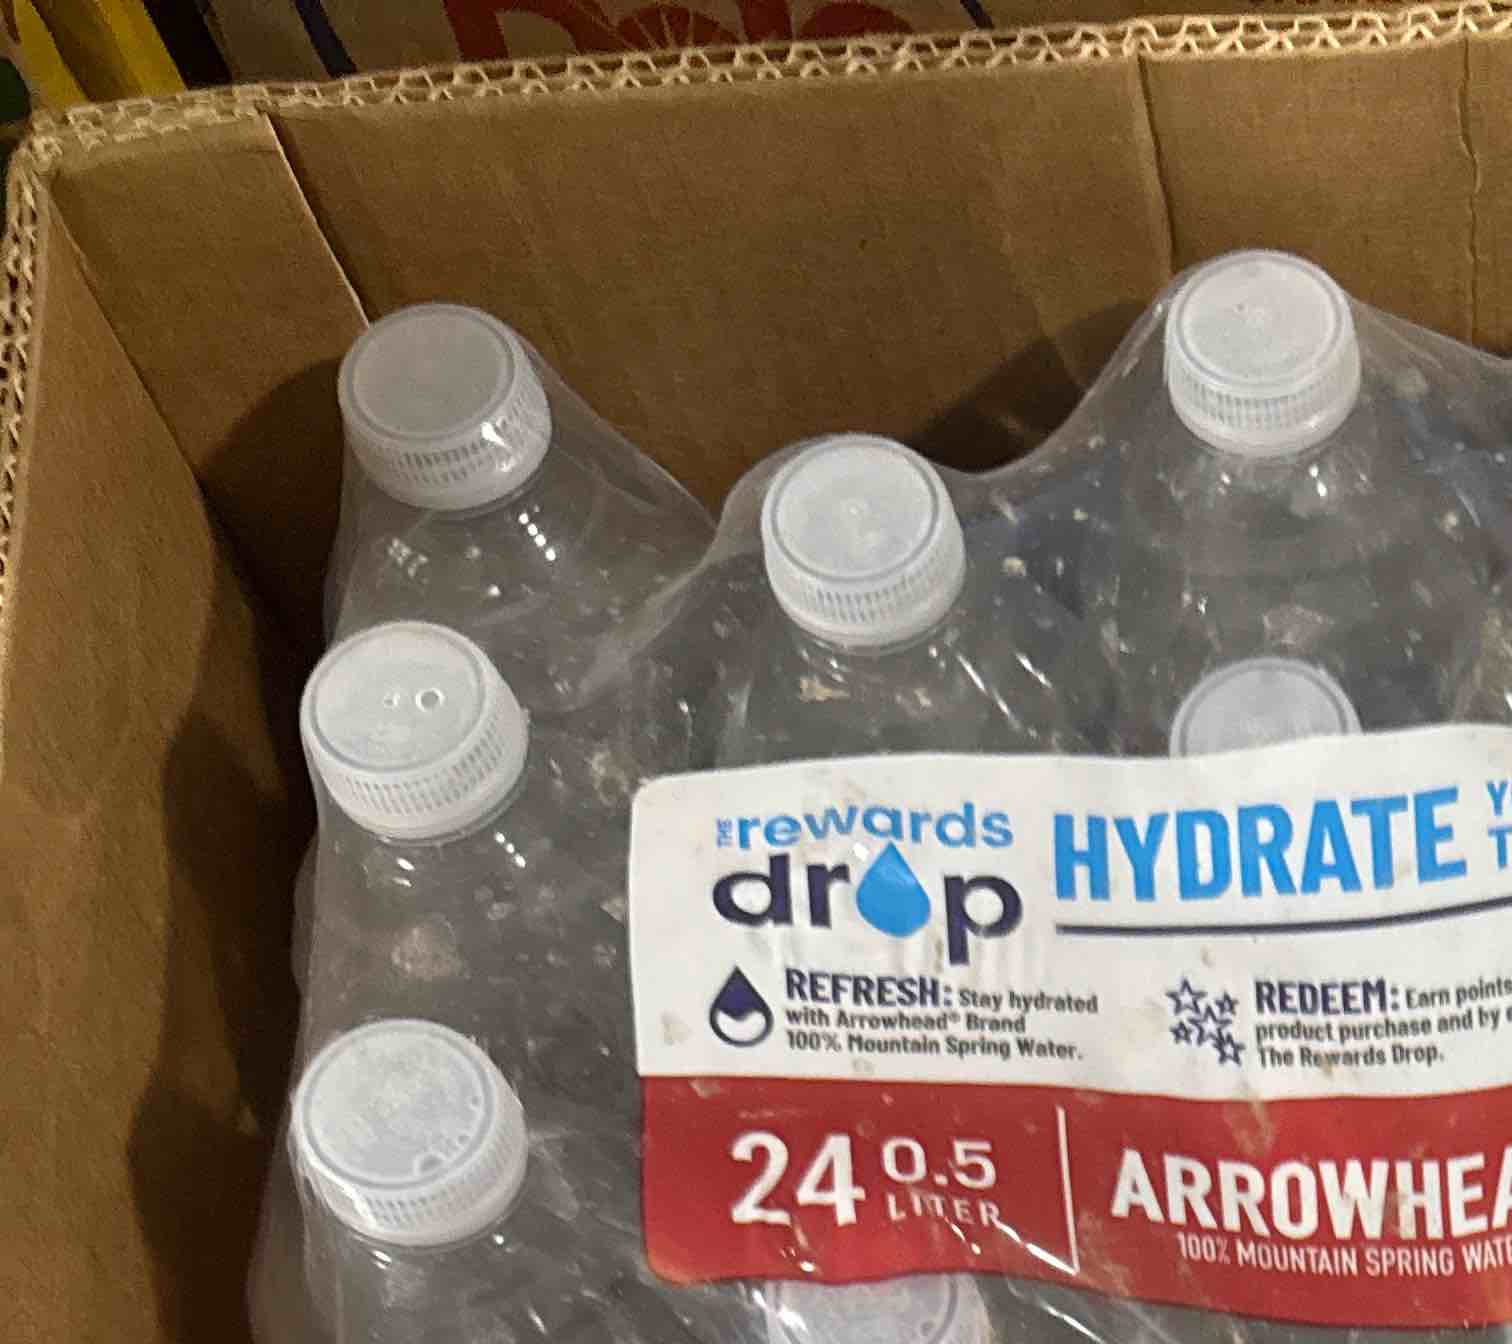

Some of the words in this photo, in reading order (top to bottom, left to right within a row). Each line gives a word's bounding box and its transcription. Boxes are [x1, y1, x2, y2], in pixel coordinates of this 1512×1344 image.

[738, 801, 1014, 850] rewards
[1053, 785, 1468, 902] HYDRATE
[785, 968, 953, 1008] REFRESH:
[958, 989, 1004, 1013] Stay
[1009, 992, 1099, 1015] hydrated
[1254, 978, 1400, 1017] REDEEM:
[1405, 987, 1451, 1010] Earn
[786, 1008, 831, 1029] with
[966, 1014, 1027, 1034] Brand
[1255, 1019, 1333, 1045] product
[1339, 1015, 1432, 1045] purchase
[1437, 1010, 1472, 1034] and
[1477, 1006, 1501, 1032] by
[786, 1031, 842, 1053] 100%
[847, 1034, 941, 1056] Mountain
[945, 1037, 1012, 1062] Spring
[1016, 1039, 1084, 1060] Water.
[1258, 1045, 1295, 1067] The
[1300, 1045, 1387, 1067] Rewards
[1391, 1041, 1445, 1067] Drop.
[729, 1130, 866, 1228] 24
[881, 1137, 998, 1189] 0.5
[886, 1192, 1003, 1227] LITER
[1177, 1231, 1232, 1264] 100%
[1237, 1238, 1358, 1276] MOUNTAIN
[1366, 1244, 1455, 1276] SPRING
